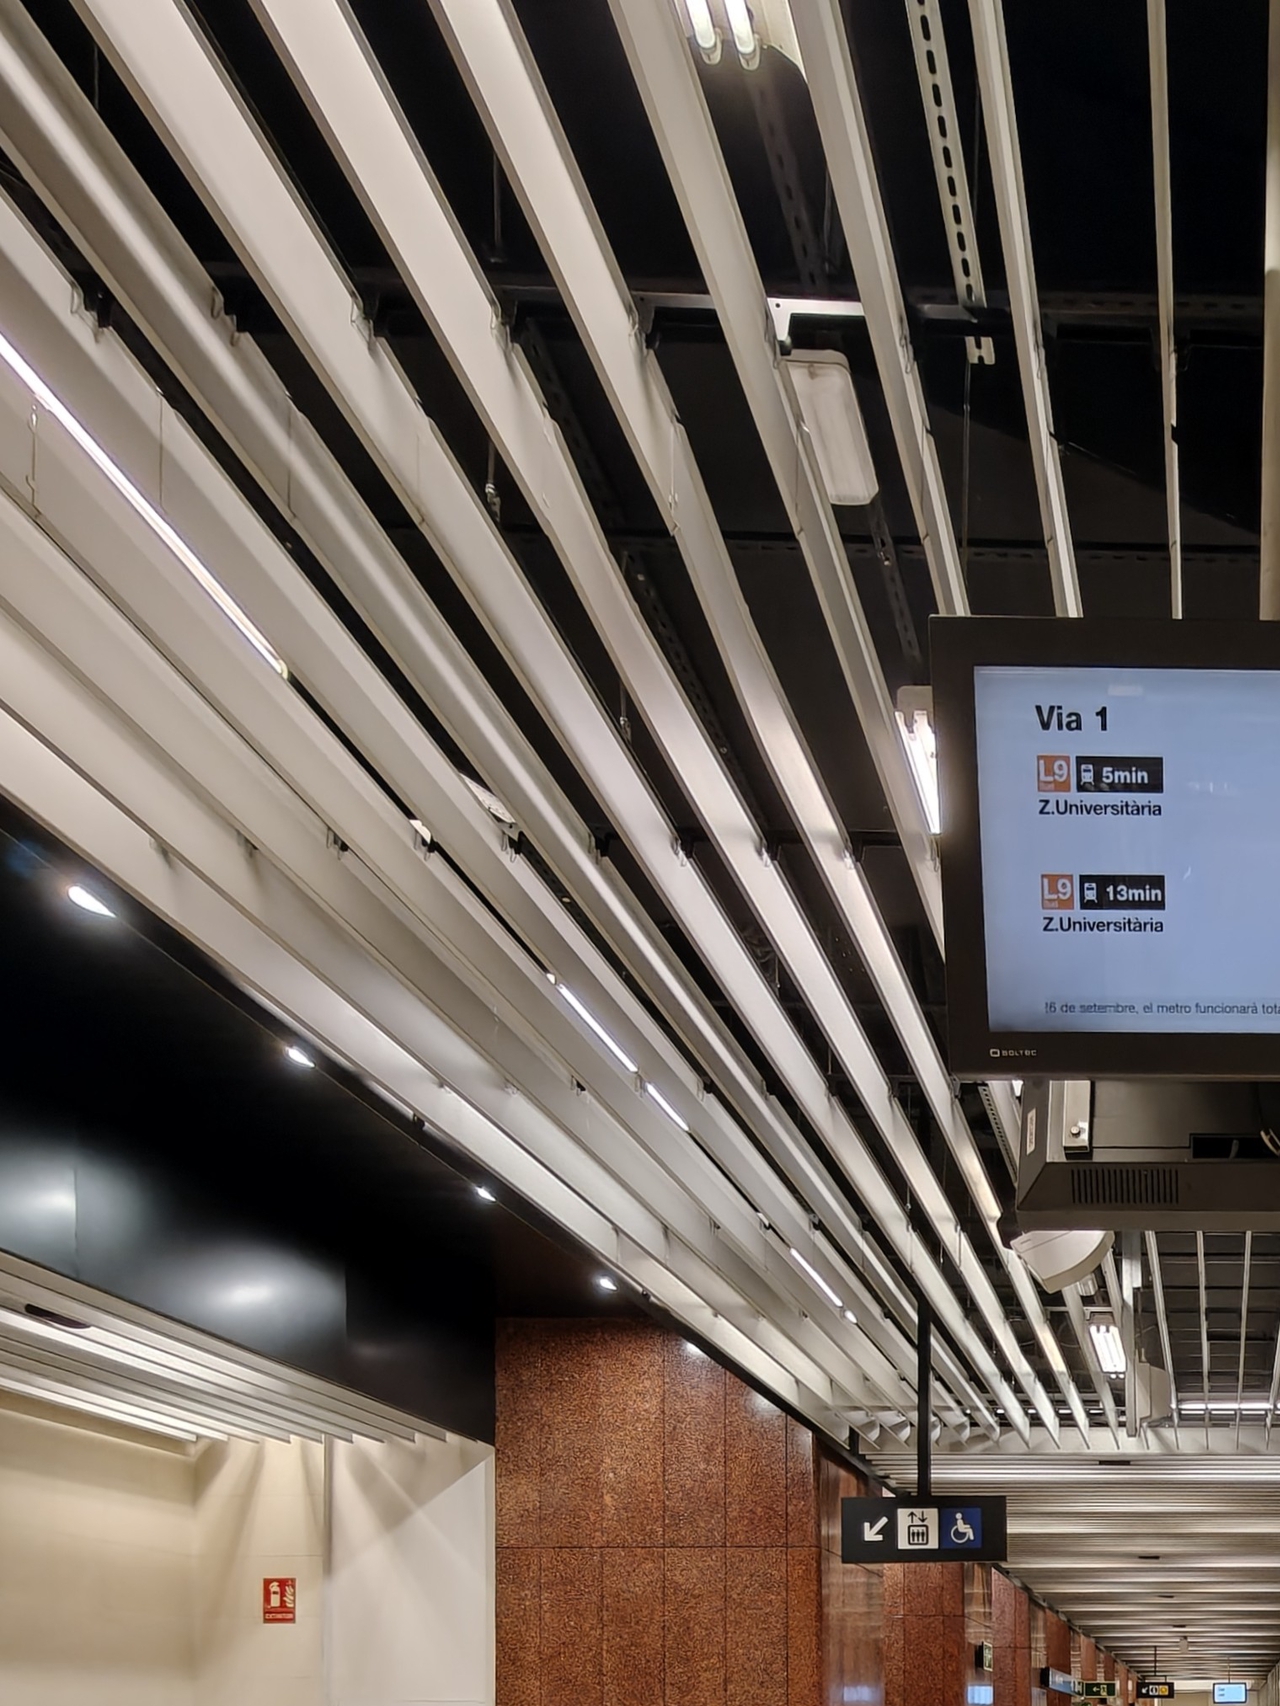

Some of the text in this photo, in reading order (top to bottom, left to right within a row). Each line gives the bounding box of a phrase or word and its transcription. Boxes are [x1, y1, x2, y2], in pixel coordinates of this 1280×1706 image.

[1035, 704, 1108, 732] Via 1
[1039, 759, 1149, 784] L9 5min
[1038, 799, 1162, 816] Z.Universitària
[1043, 878, 1162, 902] L9 13min
[1042, 916, 1164, 933] Z.Universitària
[1060, 1002, 1076, 1014] de
[1143, 1002, 1153, 1014] el
[1157, 1003, 1192, 1014] metro
[1195, 1002, 1259, 1015] funcionarà
